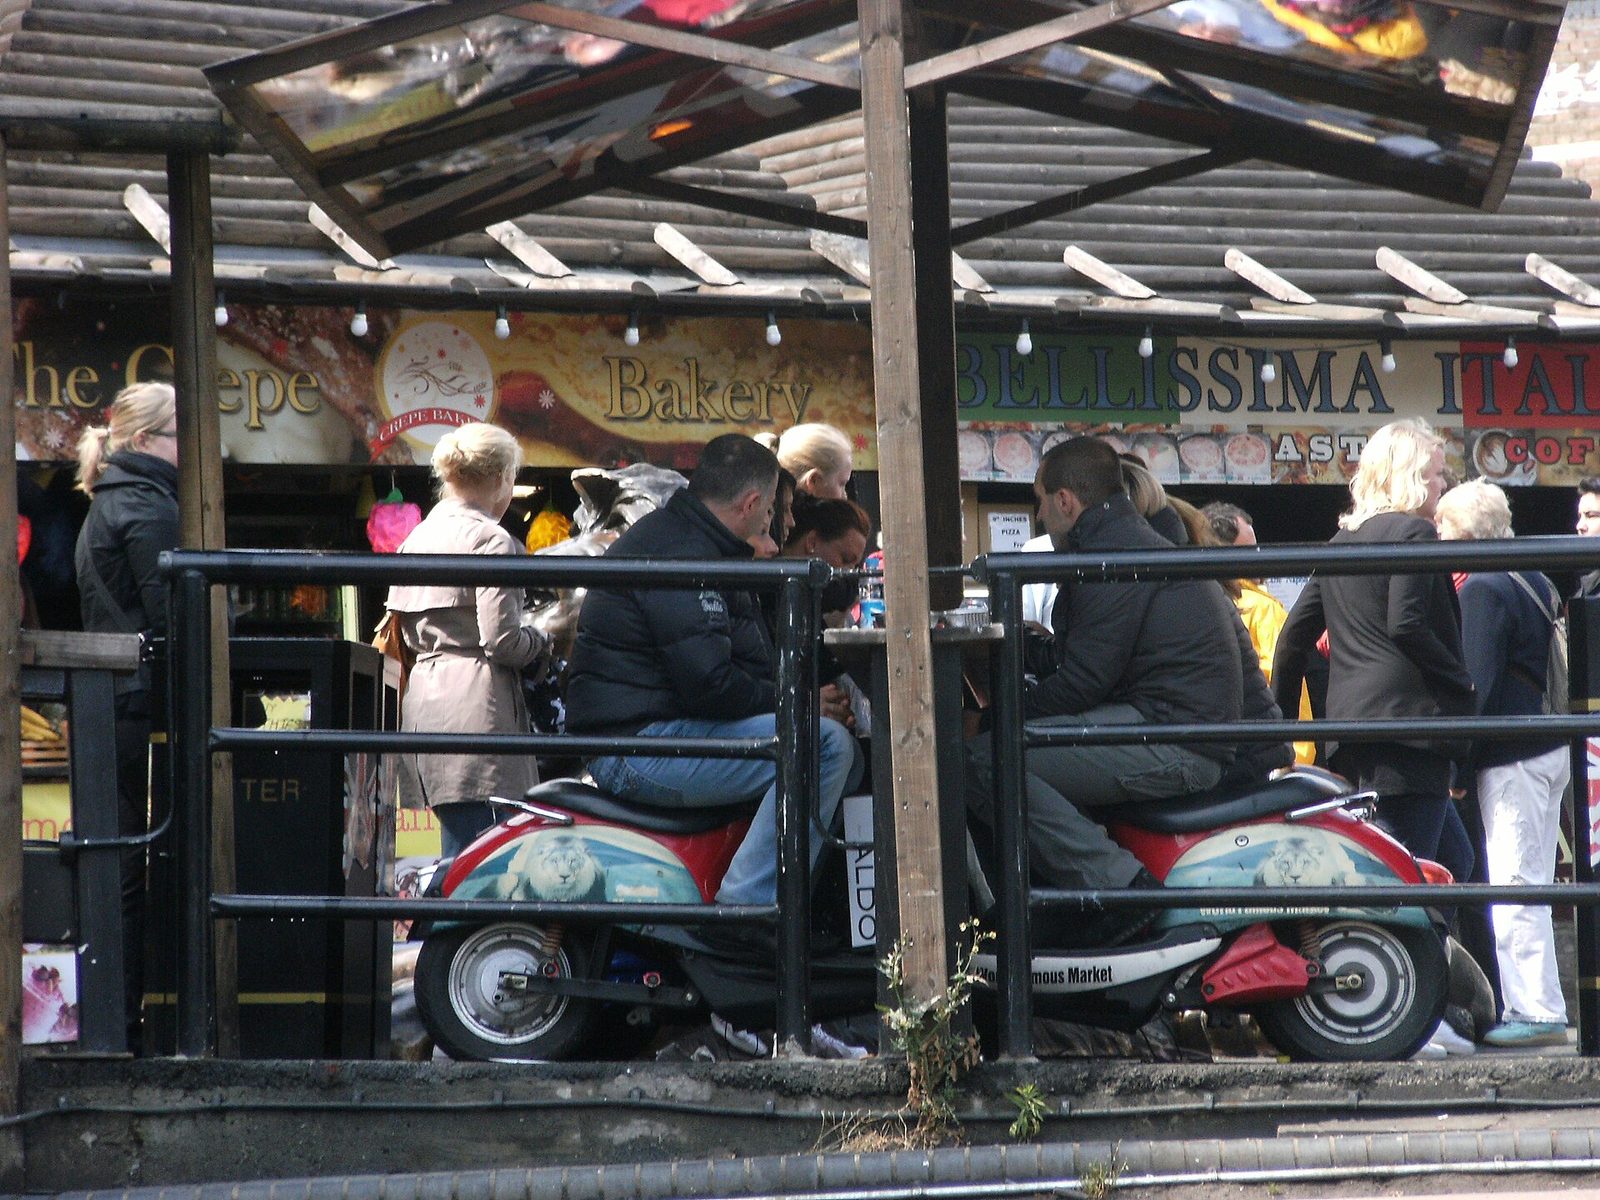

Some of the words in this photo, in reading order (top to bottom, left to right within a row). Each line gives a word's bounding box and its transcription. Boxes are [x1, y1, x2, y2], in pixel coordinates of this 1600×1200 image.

[13, 341, 99, 409] he
[602, 356, 814, 424] Bakery
[957, 345, 1395, 413] BELLISSIMA
[379, 410, 429, 441] CREPE
[854, 847, 876, 940] ALDO
[1031, 969, 1065, 985] mous
[1067, 965, 1113, 984] Market
